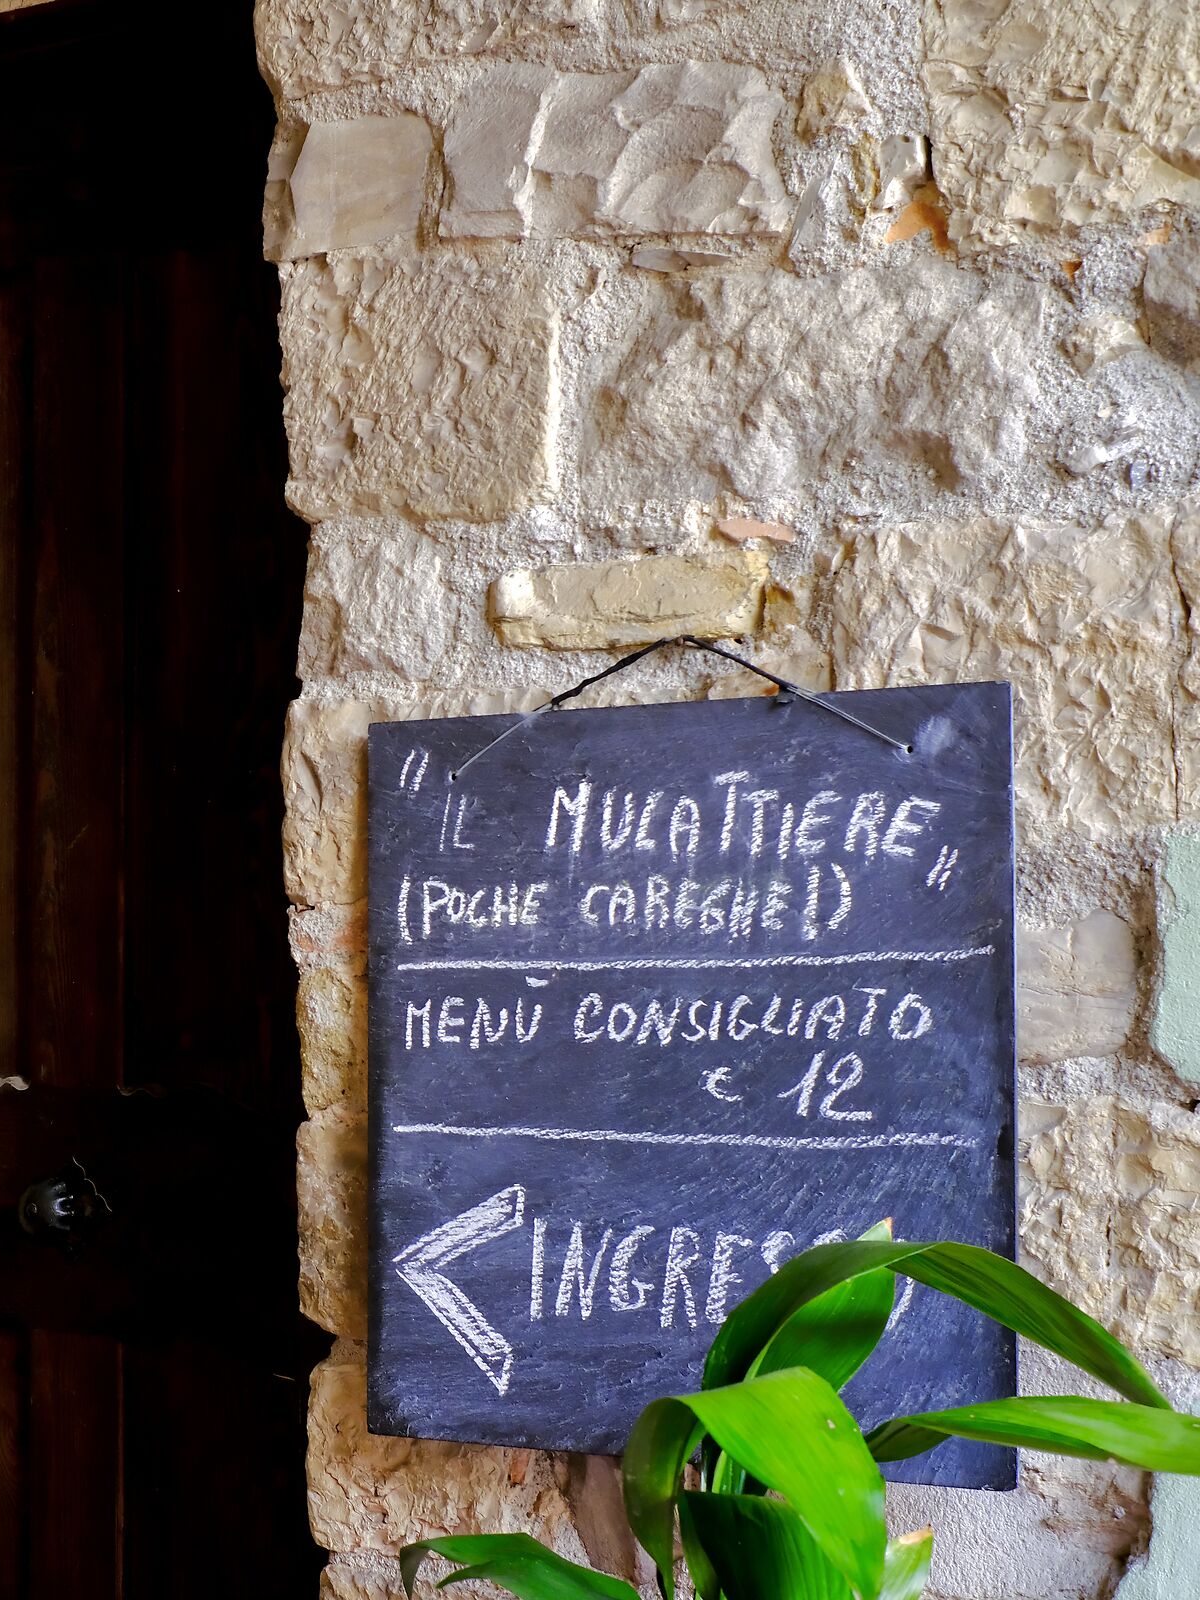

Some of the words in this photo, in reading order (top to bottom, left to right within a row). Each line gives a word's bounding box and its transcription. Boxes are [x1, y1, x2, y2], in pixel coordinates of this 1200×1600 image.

[573, 987, 933, 1046] CONSIGLIATO
[776, 1049, 874, 1122] 12
[530, 1216, 916, 1333] INGRE
